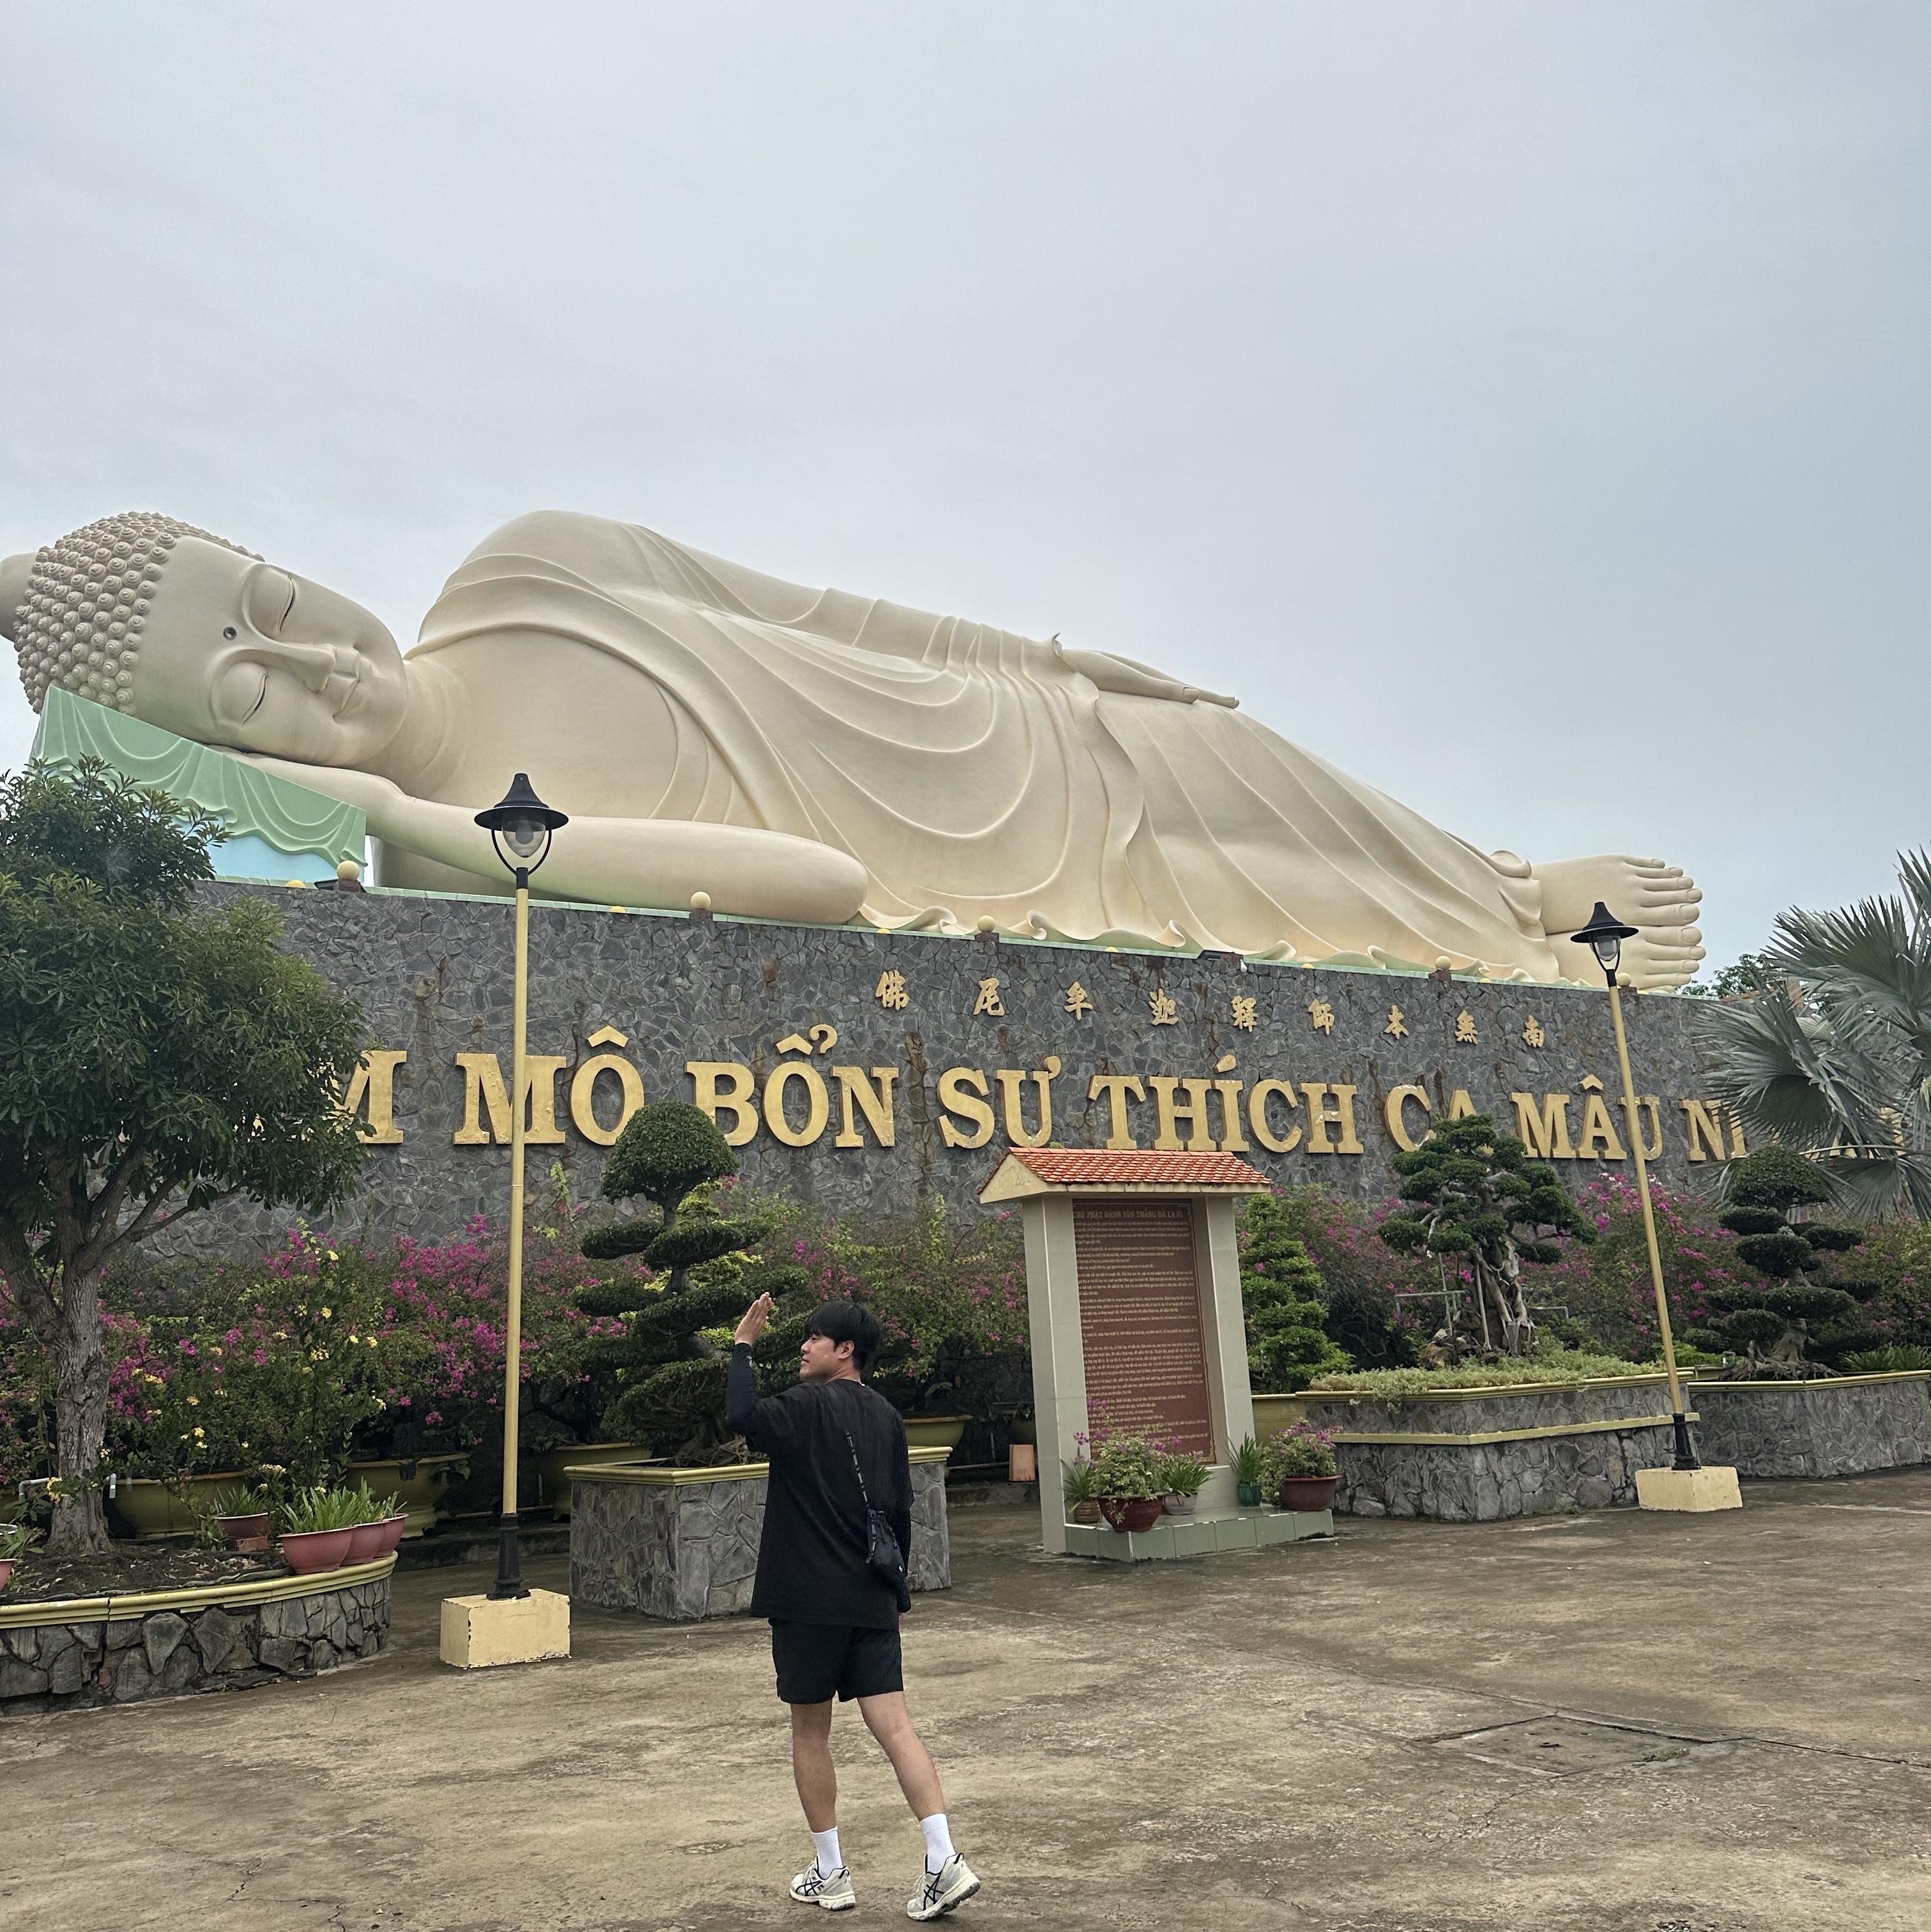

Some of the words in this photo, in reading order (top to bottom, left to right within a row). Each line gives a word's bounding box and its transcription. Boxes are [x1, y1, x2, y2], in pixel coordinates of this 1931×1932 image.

[454, 1024, 645, 1146] MÔ
[685, 1024, 899, 1148] BỔN
[936, 1056, 1061, 1149] SƯ
[1088, 1054, 1364, 1154] THÍCH
[1509, 1074, 1663, 1160] MÂU
